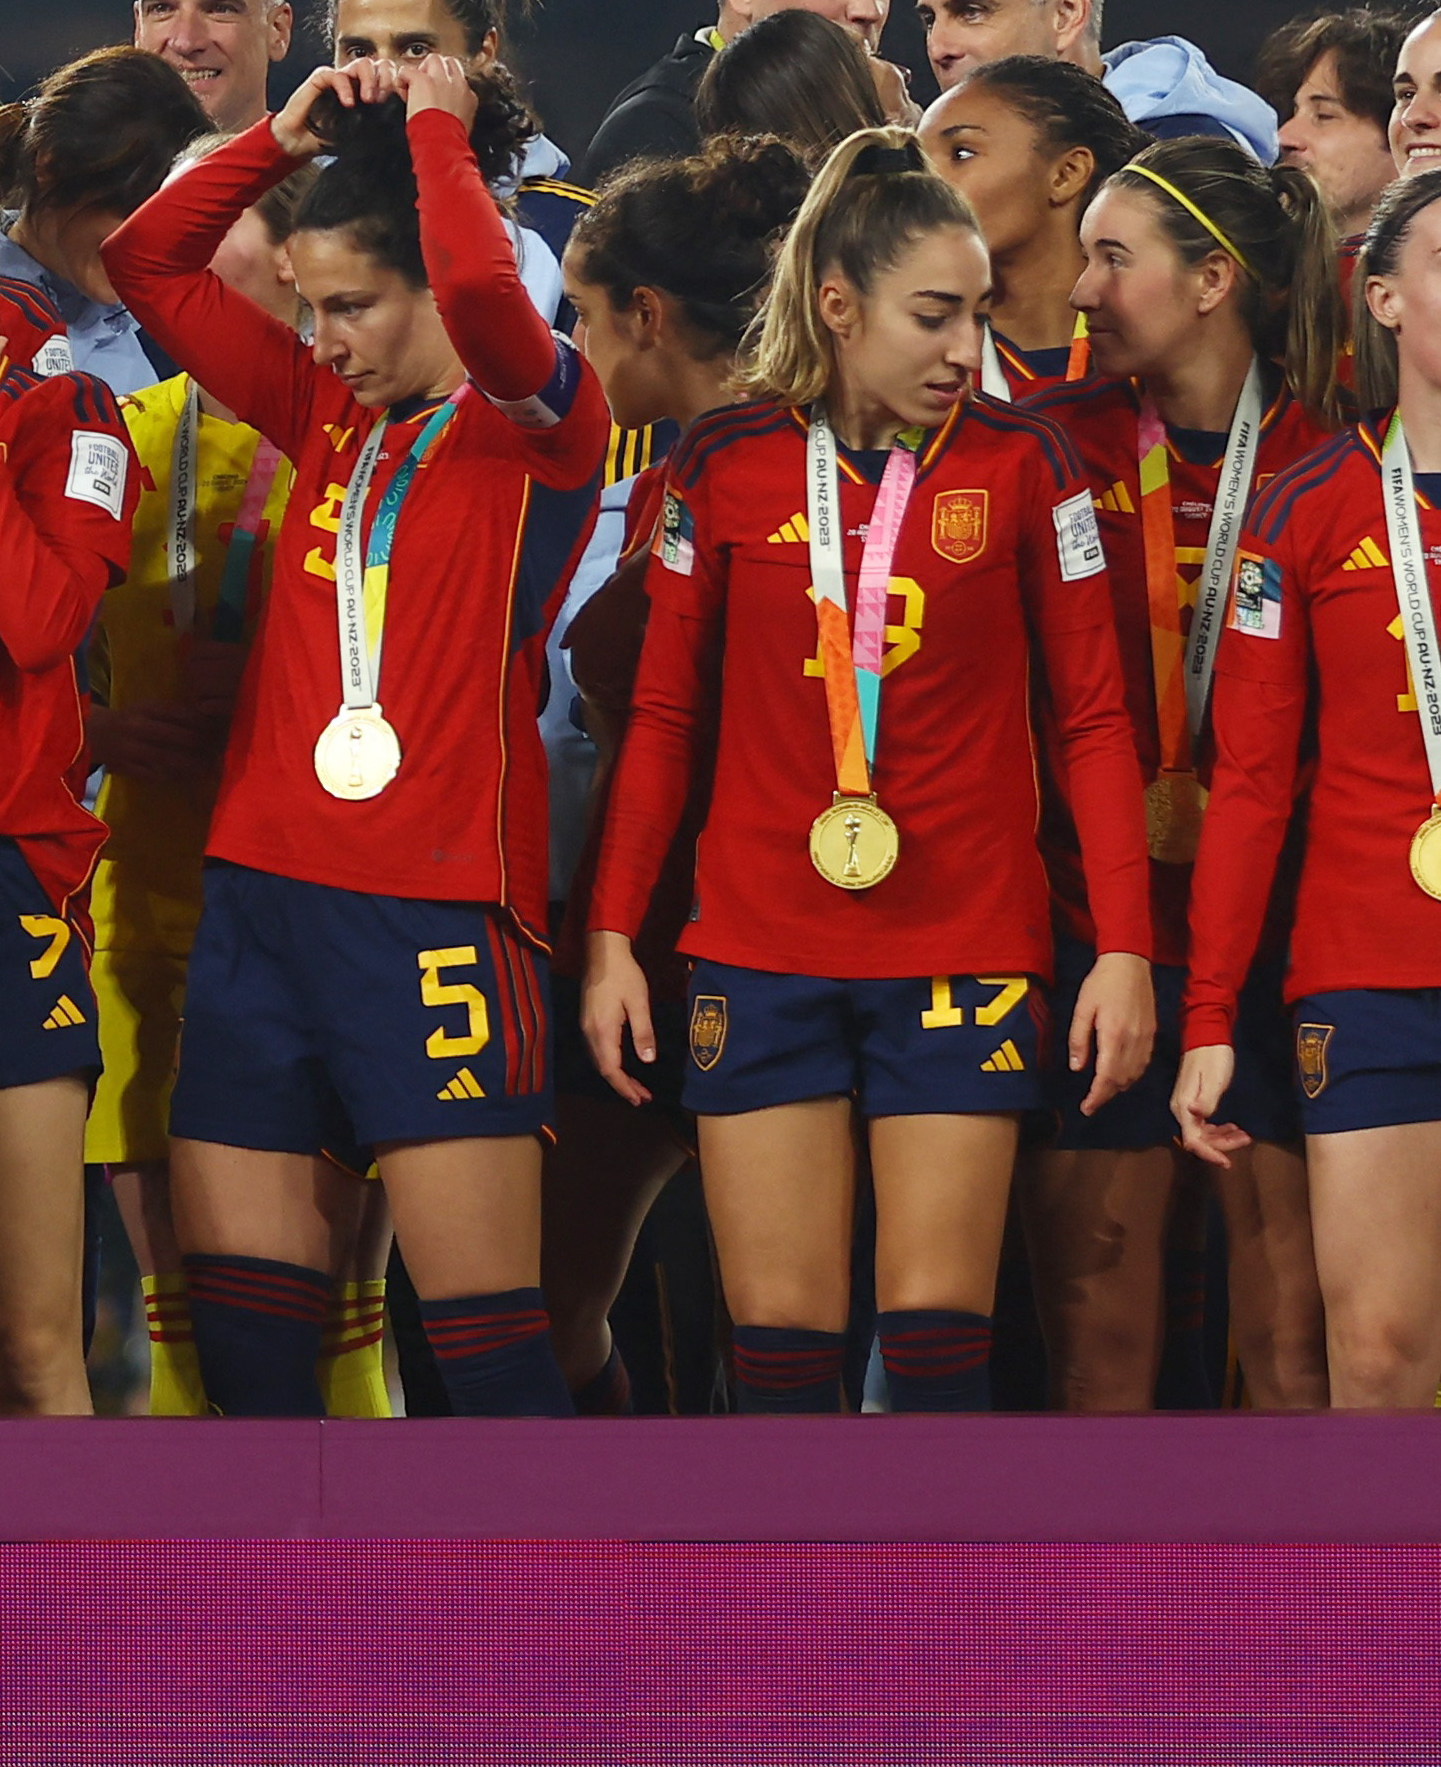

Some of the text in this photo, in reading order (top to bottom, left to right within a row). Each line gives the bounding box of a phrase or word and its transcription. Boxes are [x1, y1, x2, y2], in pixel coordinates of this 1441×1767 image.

[814, 429, 827, 456] CUP
[1237, 420, 1250, 447] FIFA
[1225, 447, 1248, 511] WOMEN'S
[1391, 467, 1404, 496] FIFA
[343, 523, 357, 567] WORLD
[1215, 511, 1237, 560] WORLD
[1394, 495, 1413, 561] WOMEN'S
[344, 570, 356, 596] CUP
[1209, 560, 1224, 586] CUP
[1403, 560, 1420, 610] WORLD
[1411, 609, 1427, 642] CUP
[418, 946, 490, 1060] 5
